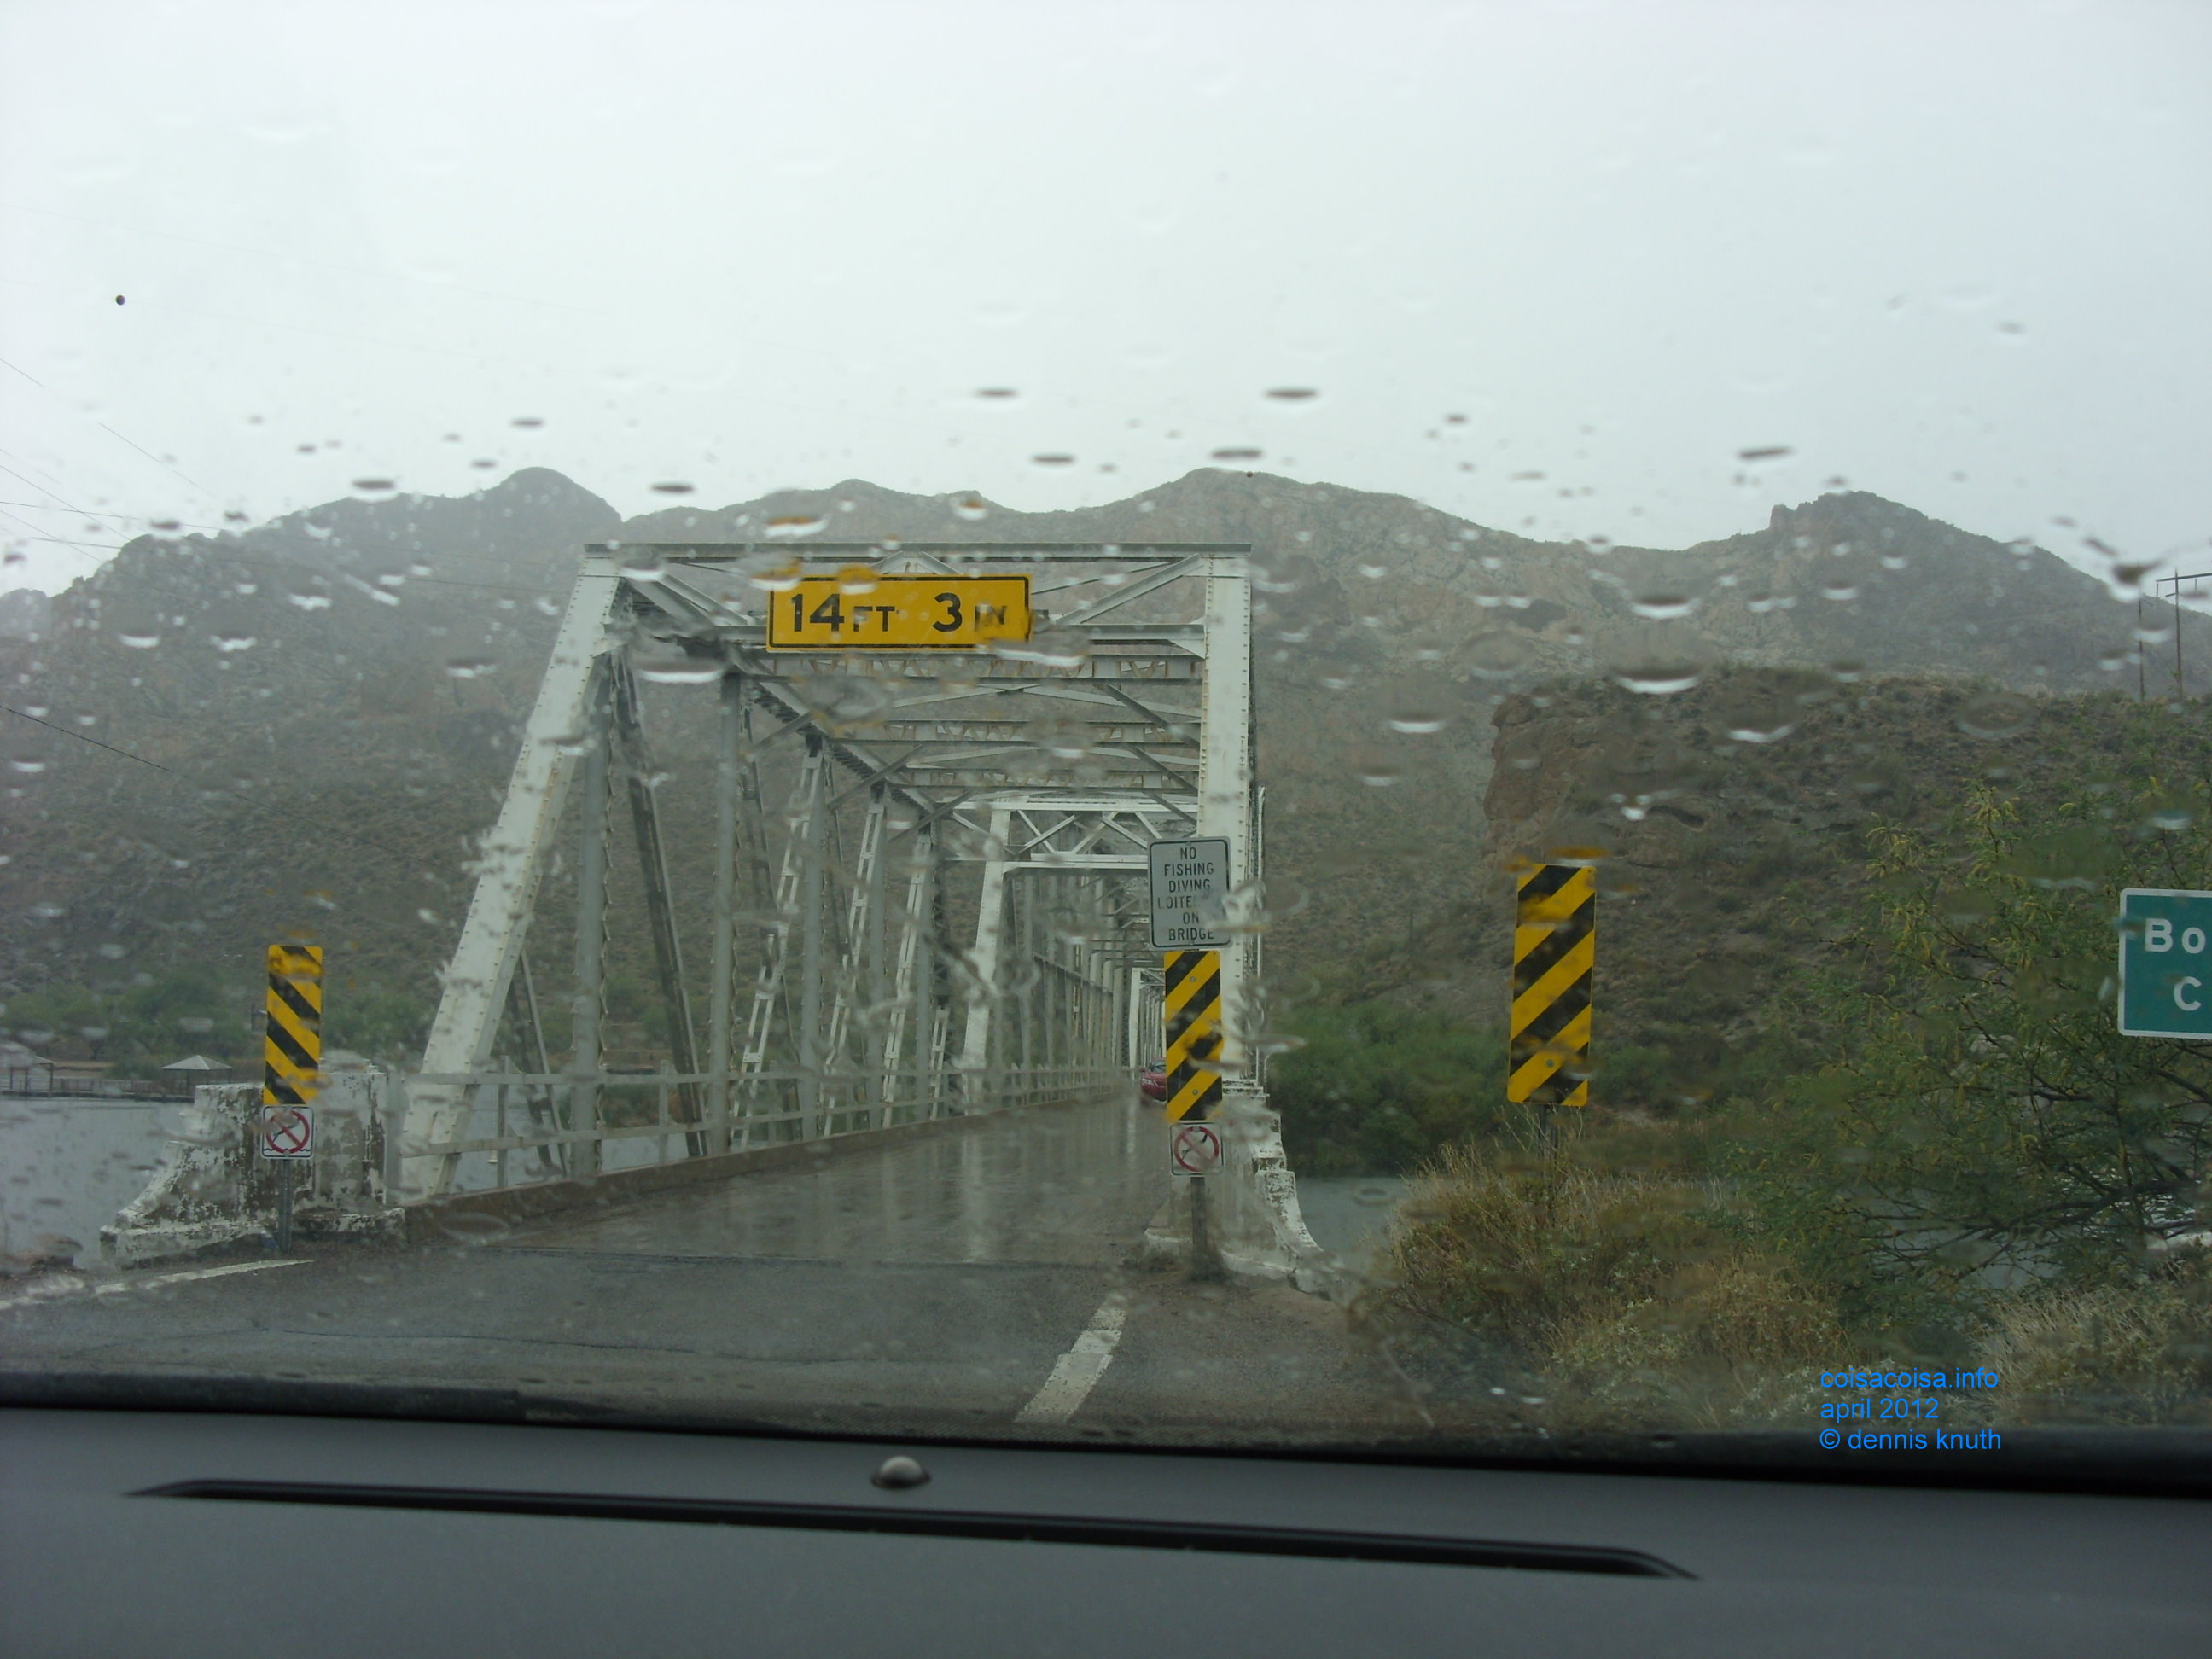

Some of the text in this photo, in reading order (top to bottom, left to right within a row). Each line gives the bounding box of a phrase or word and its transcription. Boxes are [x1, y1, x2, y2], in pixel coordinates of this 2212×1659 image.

[791, 592, 1008, 633] 14 FT 3 IN
[1180, 847, 1196, 859] NO
[1164, 862, 1214, 876] FISHING
[1168, 878, 1211, 893] DIVING
[1157, 894, 1220, 909] LOITE
[1183, 911, 1199, 924] ON
[2145, 917, 2206, 954] Bo
[2173, 976, 2203, 1011] C
